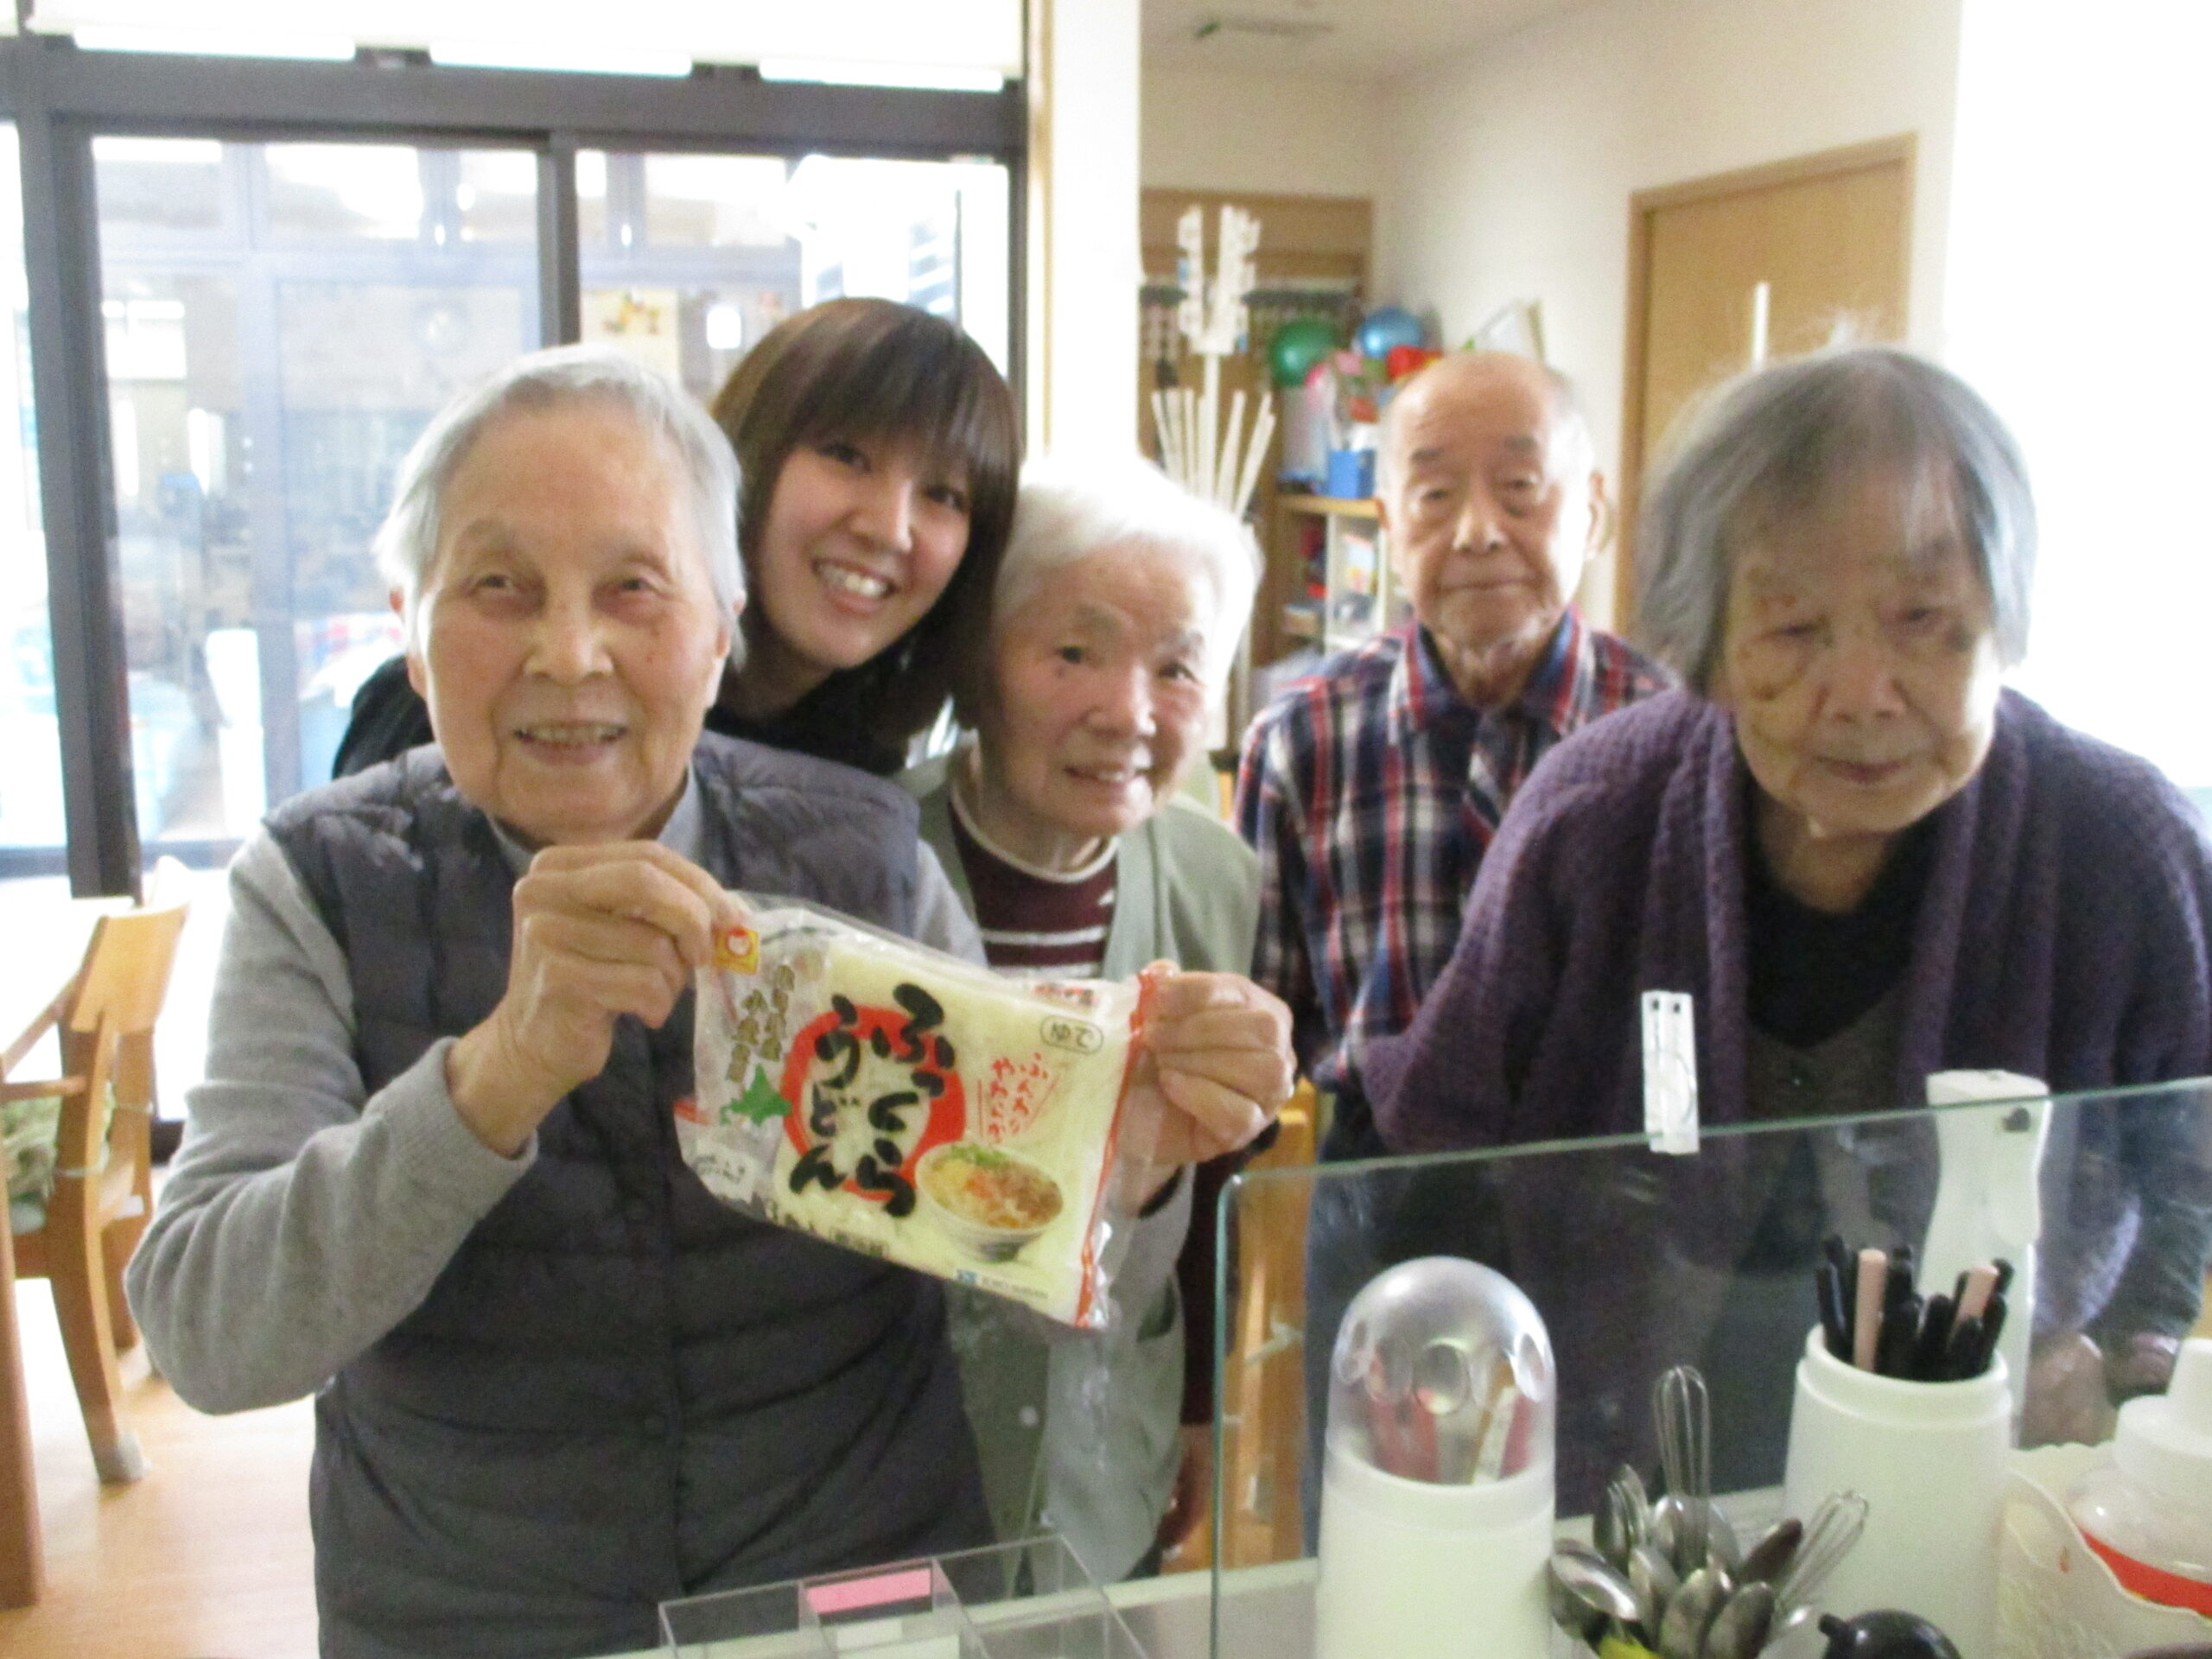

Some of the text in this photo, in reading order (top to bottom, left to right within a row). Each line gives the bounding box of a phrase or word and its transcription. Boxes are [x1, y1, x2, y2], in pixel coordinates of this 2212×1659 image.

[789, 995, 861, 1194] うどん
[855, 983, 956, 1217] ふっくら
[1050, 1022, 1096, 1048] ゆで
